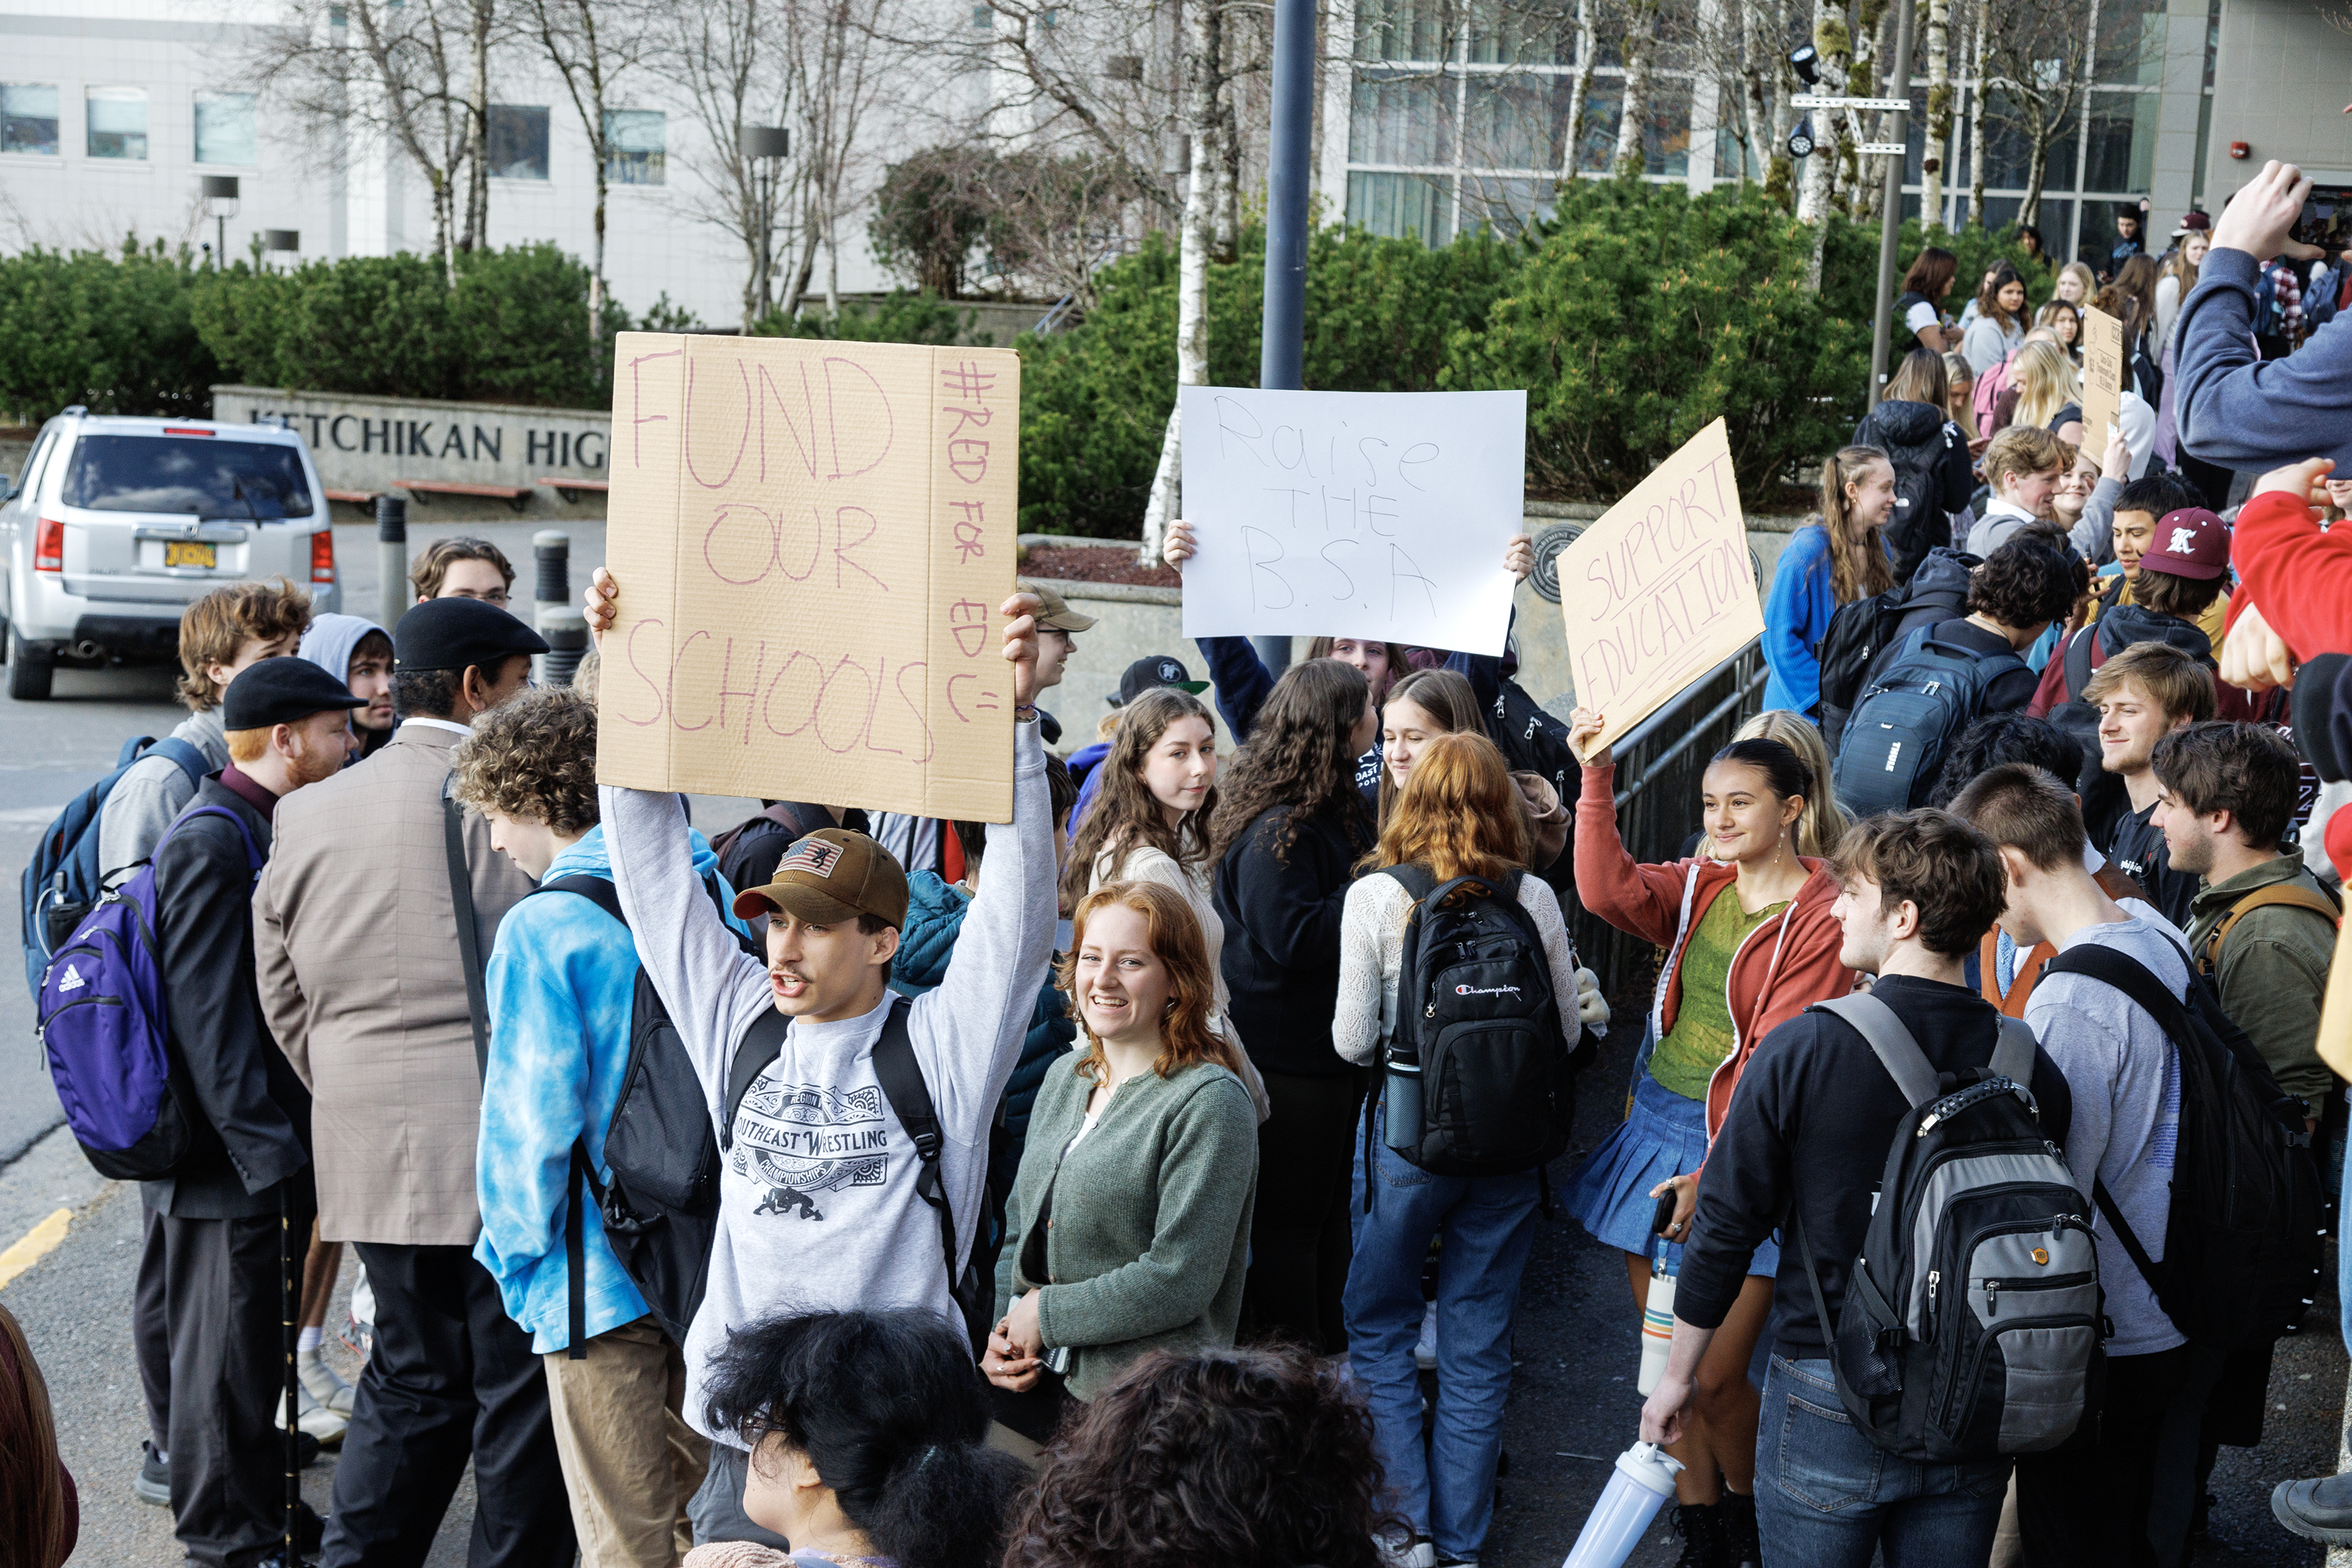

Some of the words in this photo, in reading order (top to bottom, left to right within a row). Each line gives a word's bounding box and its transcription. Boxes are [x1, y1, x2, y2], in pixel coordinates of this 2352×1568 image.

[527, 429, 611, 469] HIG
[629, 349, 893, 489] FUND
[941, 361, 996, 484] #RED
[1214, 395, 1440, 492] Raise
[949, 500, 985, 564] FOR
[1262, 485, 1400, 537] THE
[1587, 451, 1727, 622] SUPPORT
[2166, 527, 2197, 555] K
[703, 504, 889, 591] OUR
[1240, 525, 1438, 621] B.S.A
[949, 597, 988, 658] ED
[1581, 521, 1749, 714] EDUCATION
[617, 618, 934, 765] SCHOOLS
[1356, 765, 1378, 781] OAST
[1455, 984, 1521, 1001] Champion
[791, 1093, 817, 1106] REGION
[737, 1116, 800, 1150] OUTHEAST
[803, 1128, 888, 1156] WRESTLING
[760, 1159, 827, 1185] CHAMPIONSHIPS
